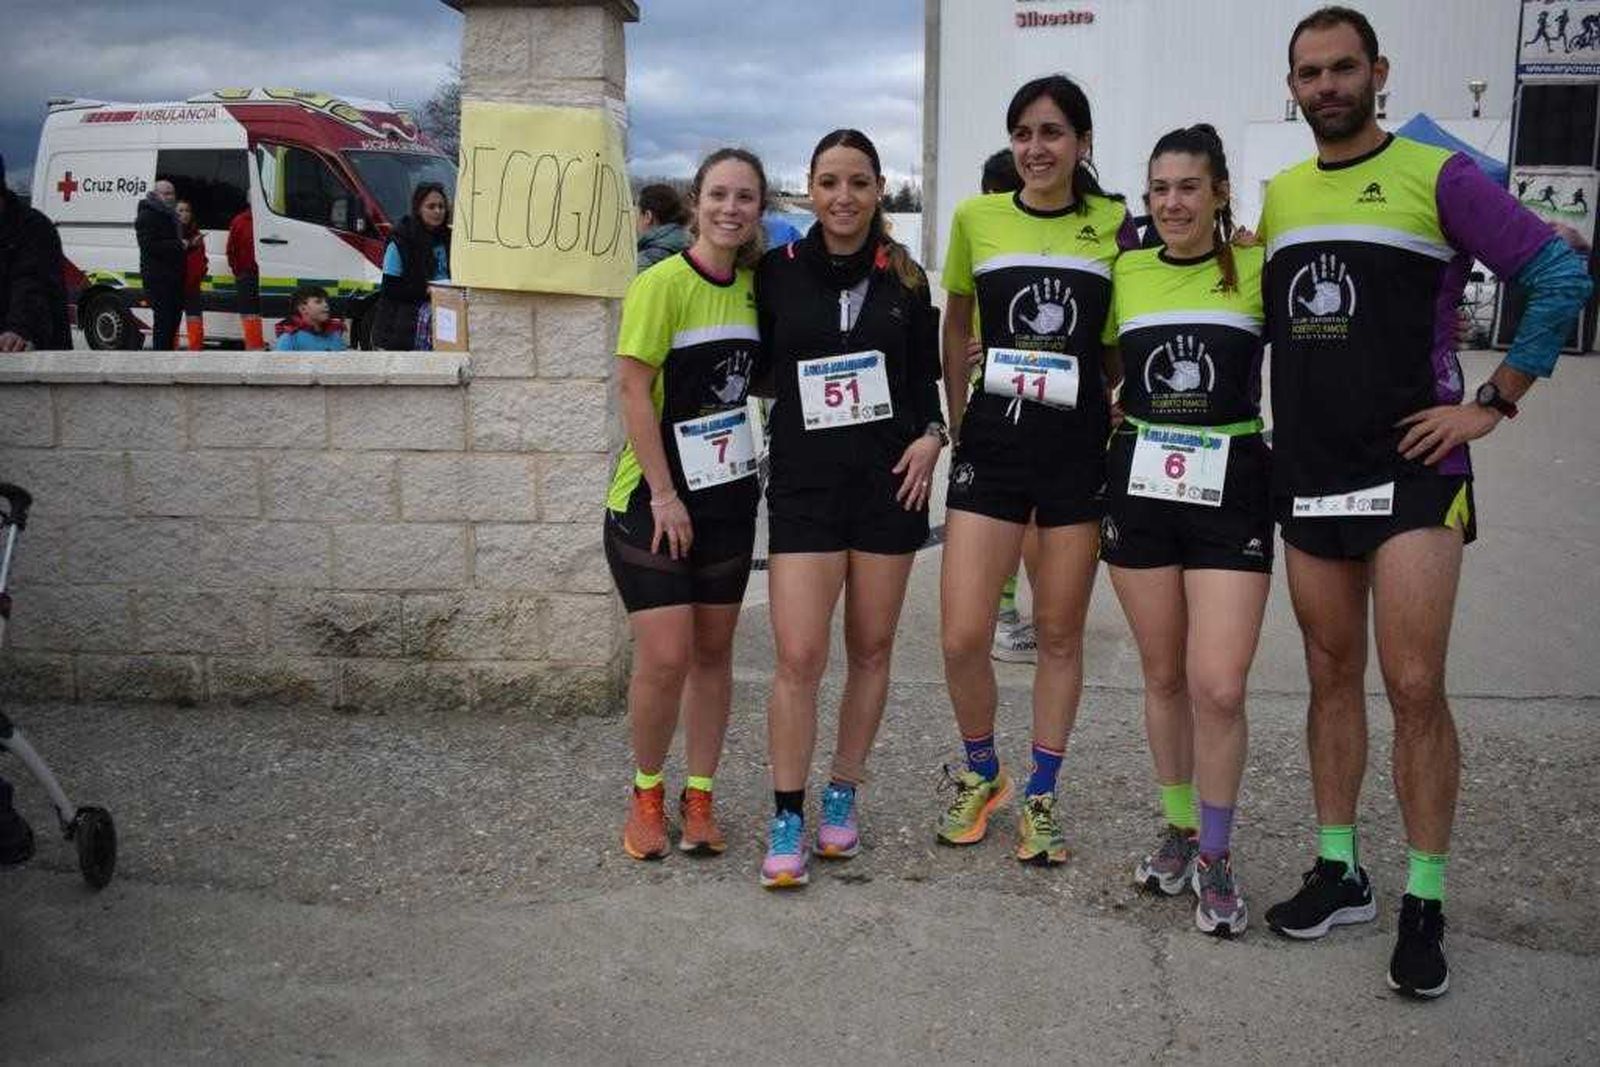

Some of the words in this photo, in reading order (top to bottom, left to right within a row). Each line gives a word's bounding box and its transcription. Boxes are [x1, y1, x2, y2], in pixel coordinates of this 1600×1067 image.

[132, 107, 217, 122] AMBULANCIA
[82, 177, 113, 193] Cruz
[117, 177, 147, 196] Roja
[824, 378, 860, 408] 51
[1012, 373, 1047, 401] 11
[712, 437, 729, 464] 7
[1165, 452, 1186, 479] 6
